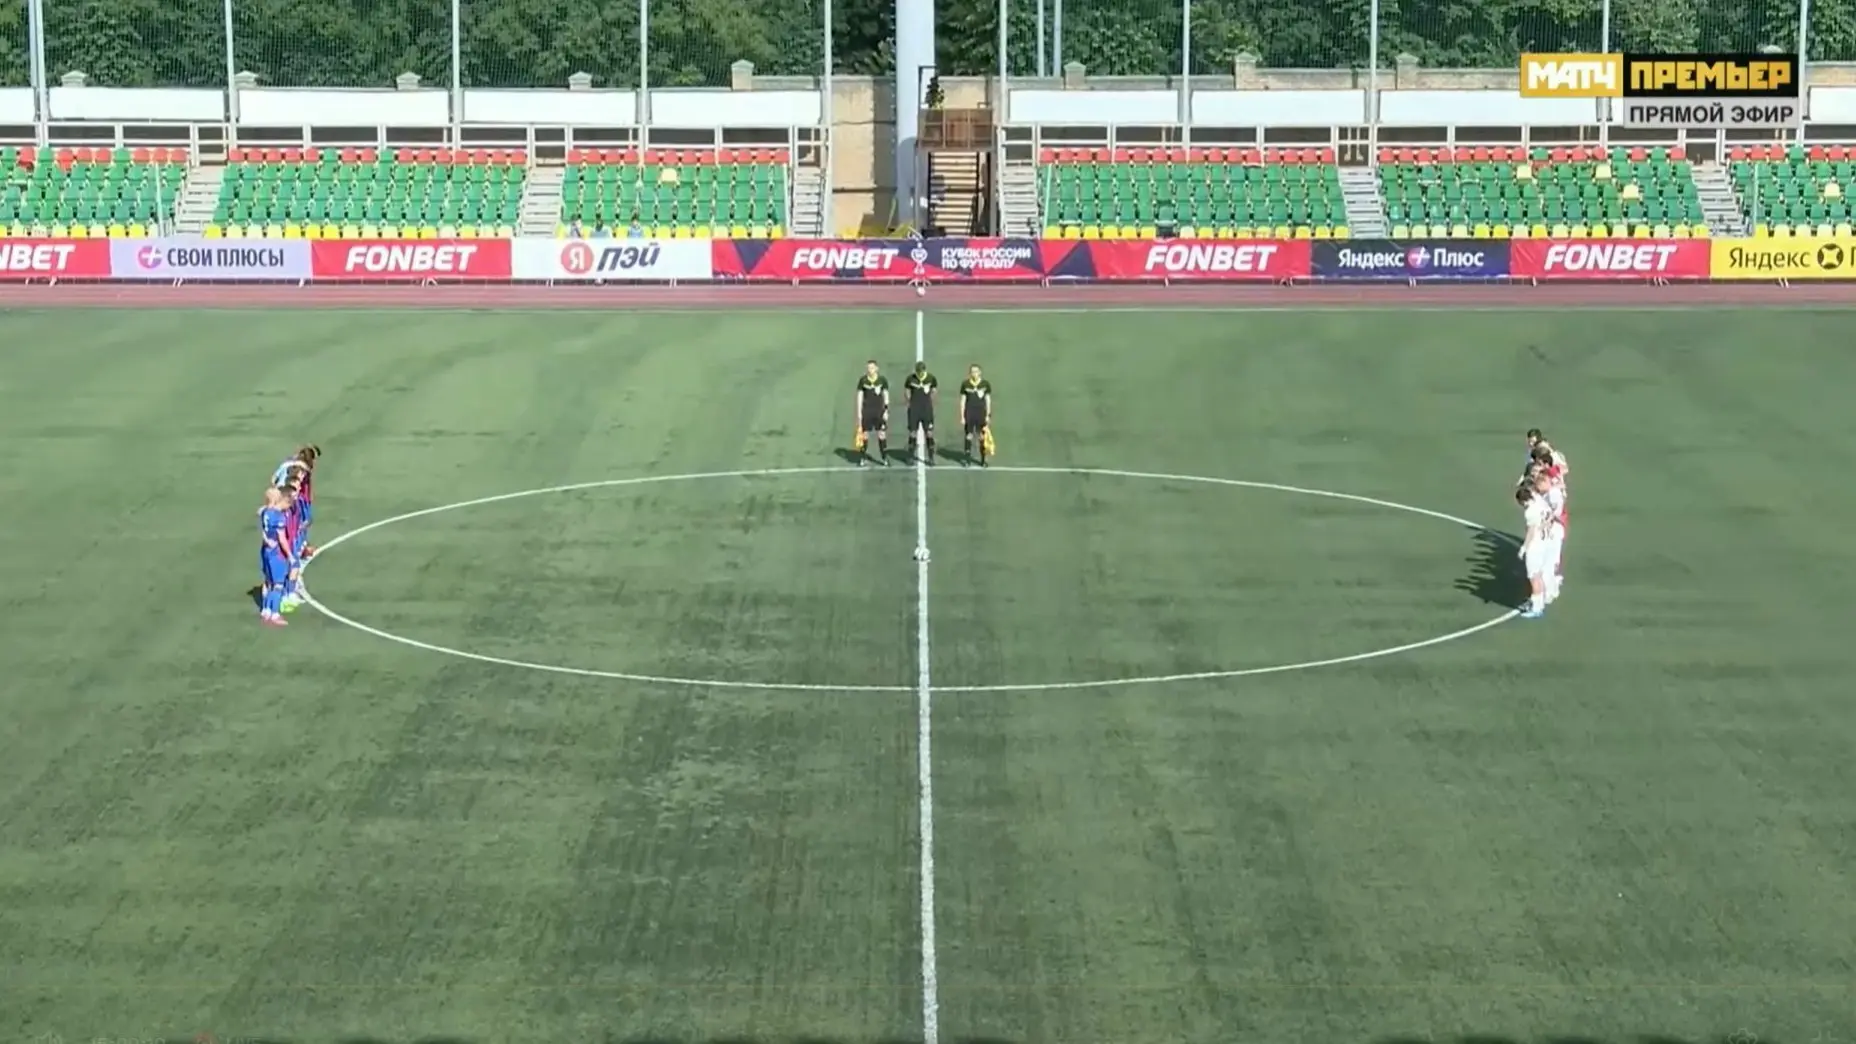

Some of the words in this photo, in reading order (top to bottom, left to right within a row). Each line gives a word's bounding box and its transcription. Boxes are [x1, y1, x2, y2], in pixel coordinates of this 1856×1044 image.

[217, 248, 284, 268] ПЛЮСЫ
[345, 245, 478, 272] FONBET
[792, 248, 899, 270] FONBET
[942, 247, 981, 258] КУБОК
[983, 247, 1031, 258] РОССИИ
[1145, 245, 1277, 272] FONBET
[1338, 248, 1405, 268] Яндекс
[1433, 247, 1485, 268] Плюс
[1544, 245, 1678, 271] FONBET
[1728, 247, 1811, 270] Яндекс
[942, 259, 958, 269] ПО
[960, 259, 1017, 270] ФУТБОЛУ
